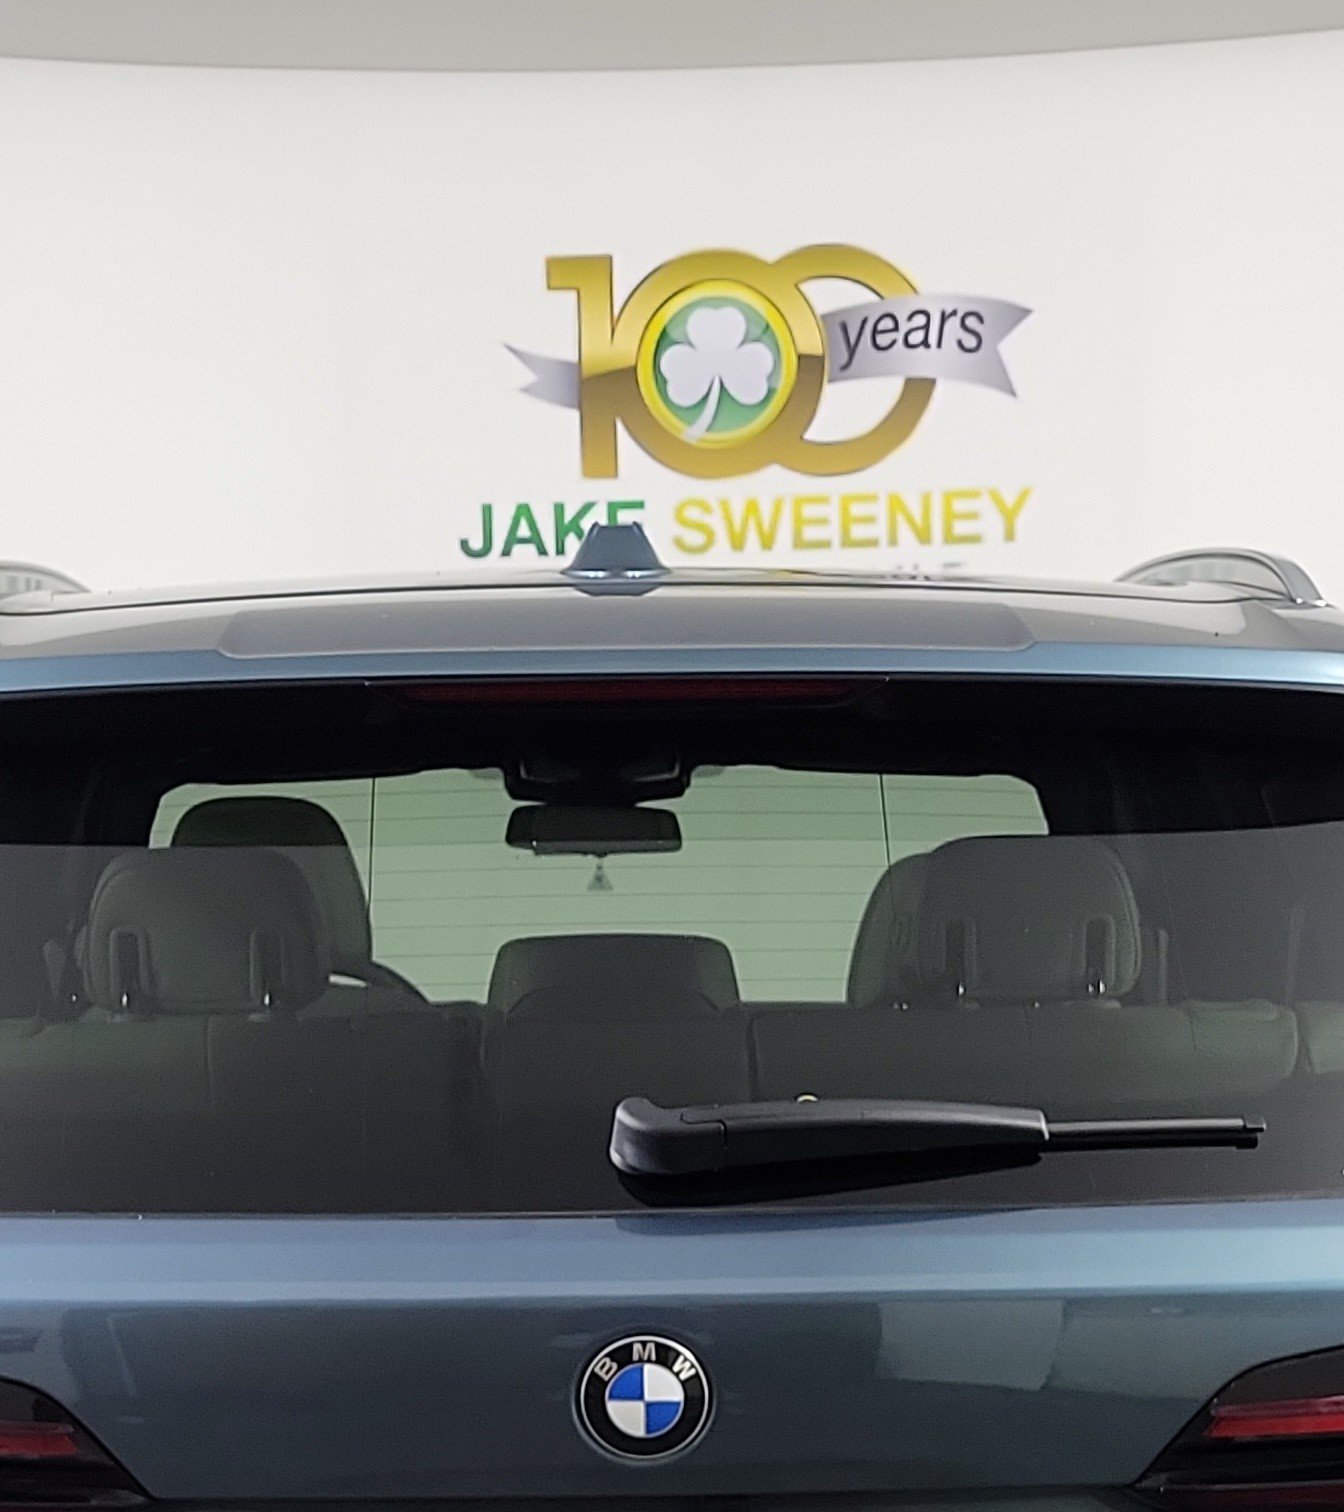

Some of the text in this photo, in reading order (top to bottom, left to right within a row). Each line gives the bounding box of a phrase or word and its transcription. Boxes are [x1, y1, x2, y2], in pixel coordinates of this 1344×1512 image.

[839, 305, 986, 371] years
[672, 488, 1034, 555] SWEENEY
[593, 1342, 697, 1381] BMW
